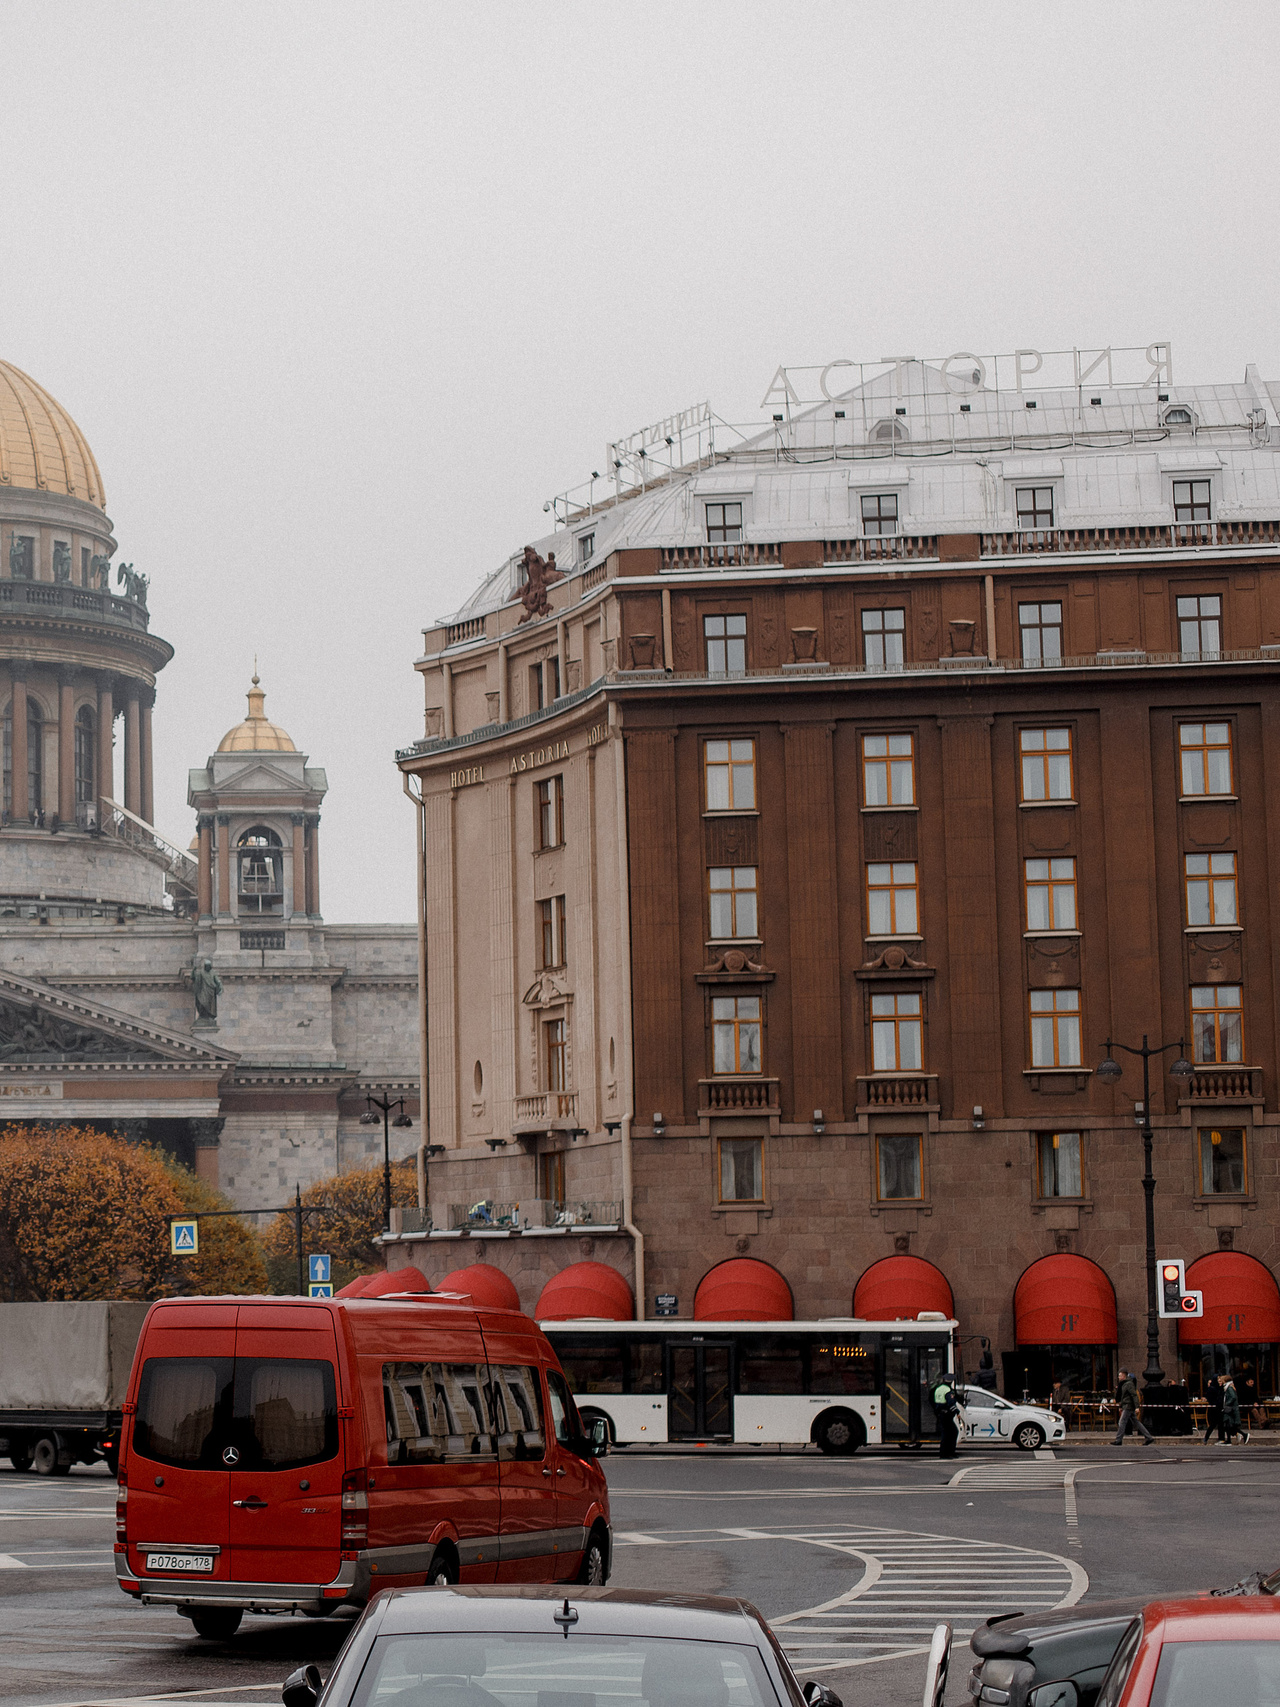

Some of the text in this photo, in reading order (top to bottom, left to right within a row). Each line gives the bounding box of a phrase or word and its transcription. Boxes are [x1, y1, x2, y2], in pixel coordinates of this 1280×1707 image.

[760, 341, 1173, 408] АСТОРИЯ
[451, 766, 484, 788] HOTEL
[510, 740, 570, 773] ASTORIA
[194, 1557, 211, 1567] 178
